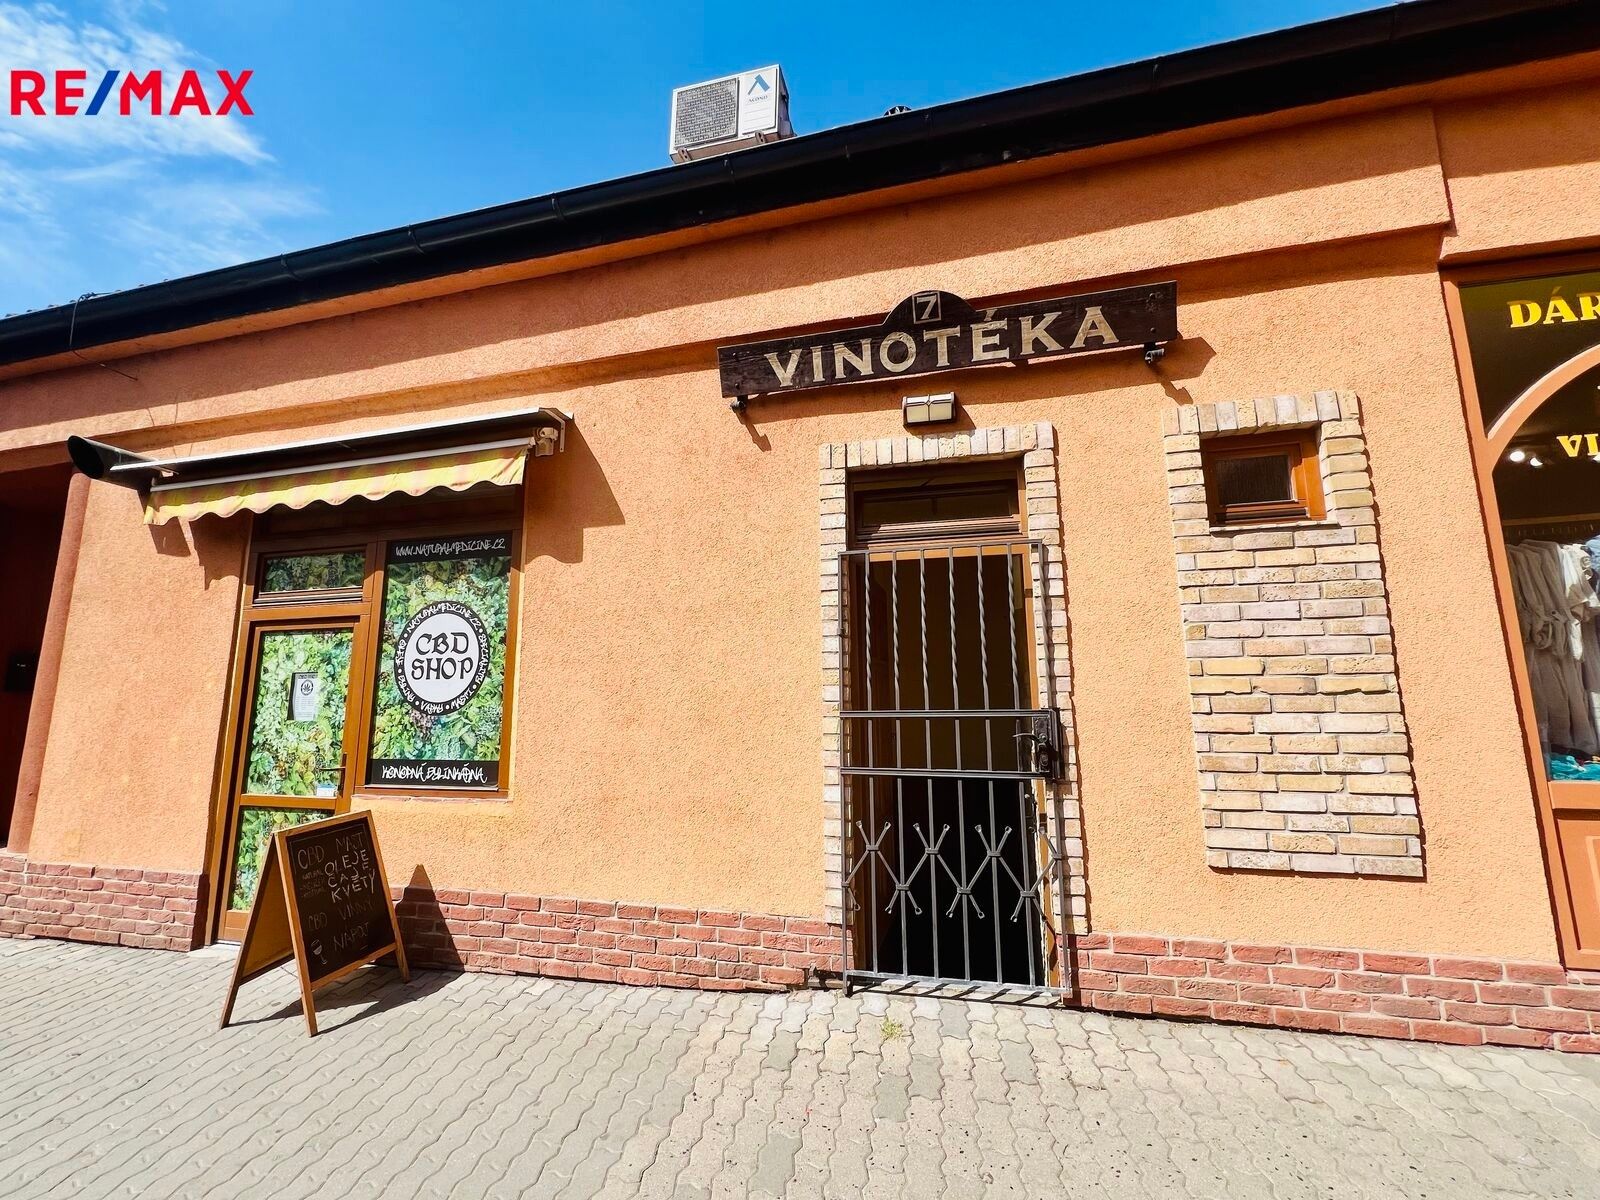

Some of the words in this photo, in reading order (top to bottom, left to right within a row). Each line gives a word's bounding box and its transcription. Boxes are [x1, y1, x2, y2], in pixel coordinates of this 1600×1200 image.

[916, 296, 938, 320] 7
[764, 306, 1119, 387] VINOTÉKA
[415, 632, 469, 656] CBD
[411, 656, 474, 681] SHOP
[297, 845, 325, 870] CBD
[325, 849, 369, 877] OLEJE
